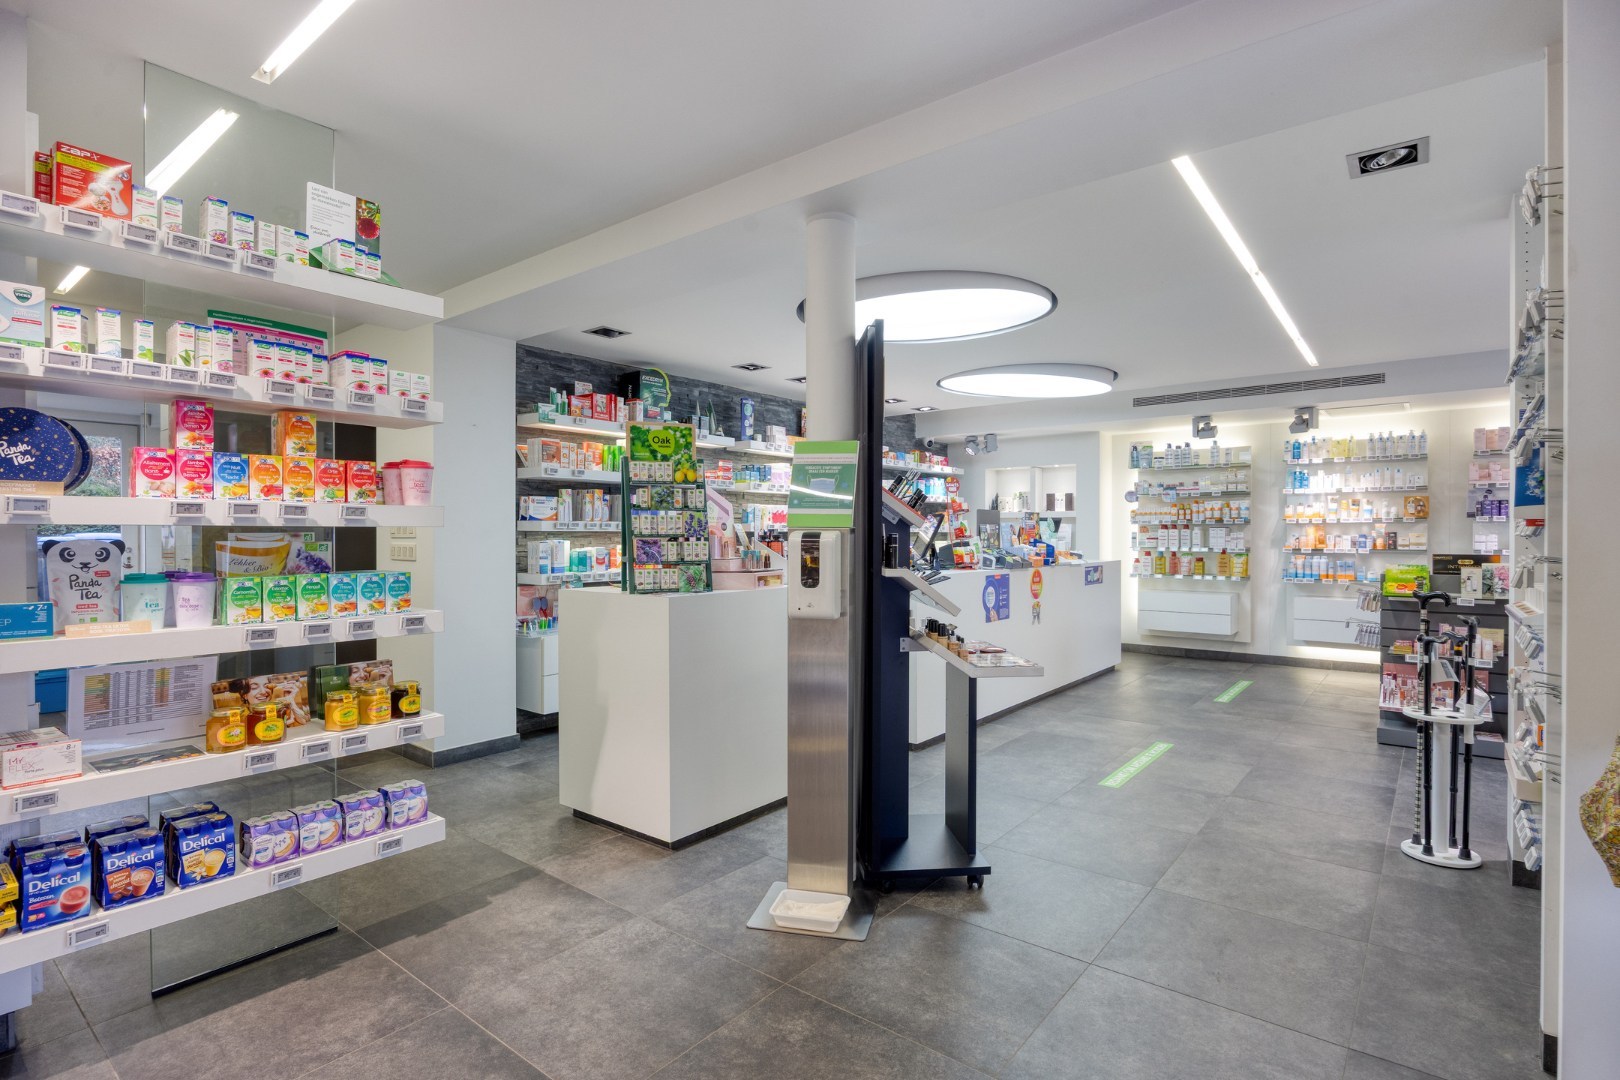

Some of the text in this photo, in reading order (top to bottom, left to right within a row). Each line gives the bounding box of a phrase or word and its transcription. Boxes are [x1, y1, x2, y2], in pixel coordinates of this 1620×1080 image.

[652, 436, 671, 444] Oak
[0, 441, 31, 457] Panda
[7, 453, 35, 465] Tea
[69, 574, 102, 590] Panda
[75, 588, 102, 600] Tea
[183, 833, 225, 851] Delical
[107, 850, 154, 870] Delical
[29, 872, 80, 893] Delical
